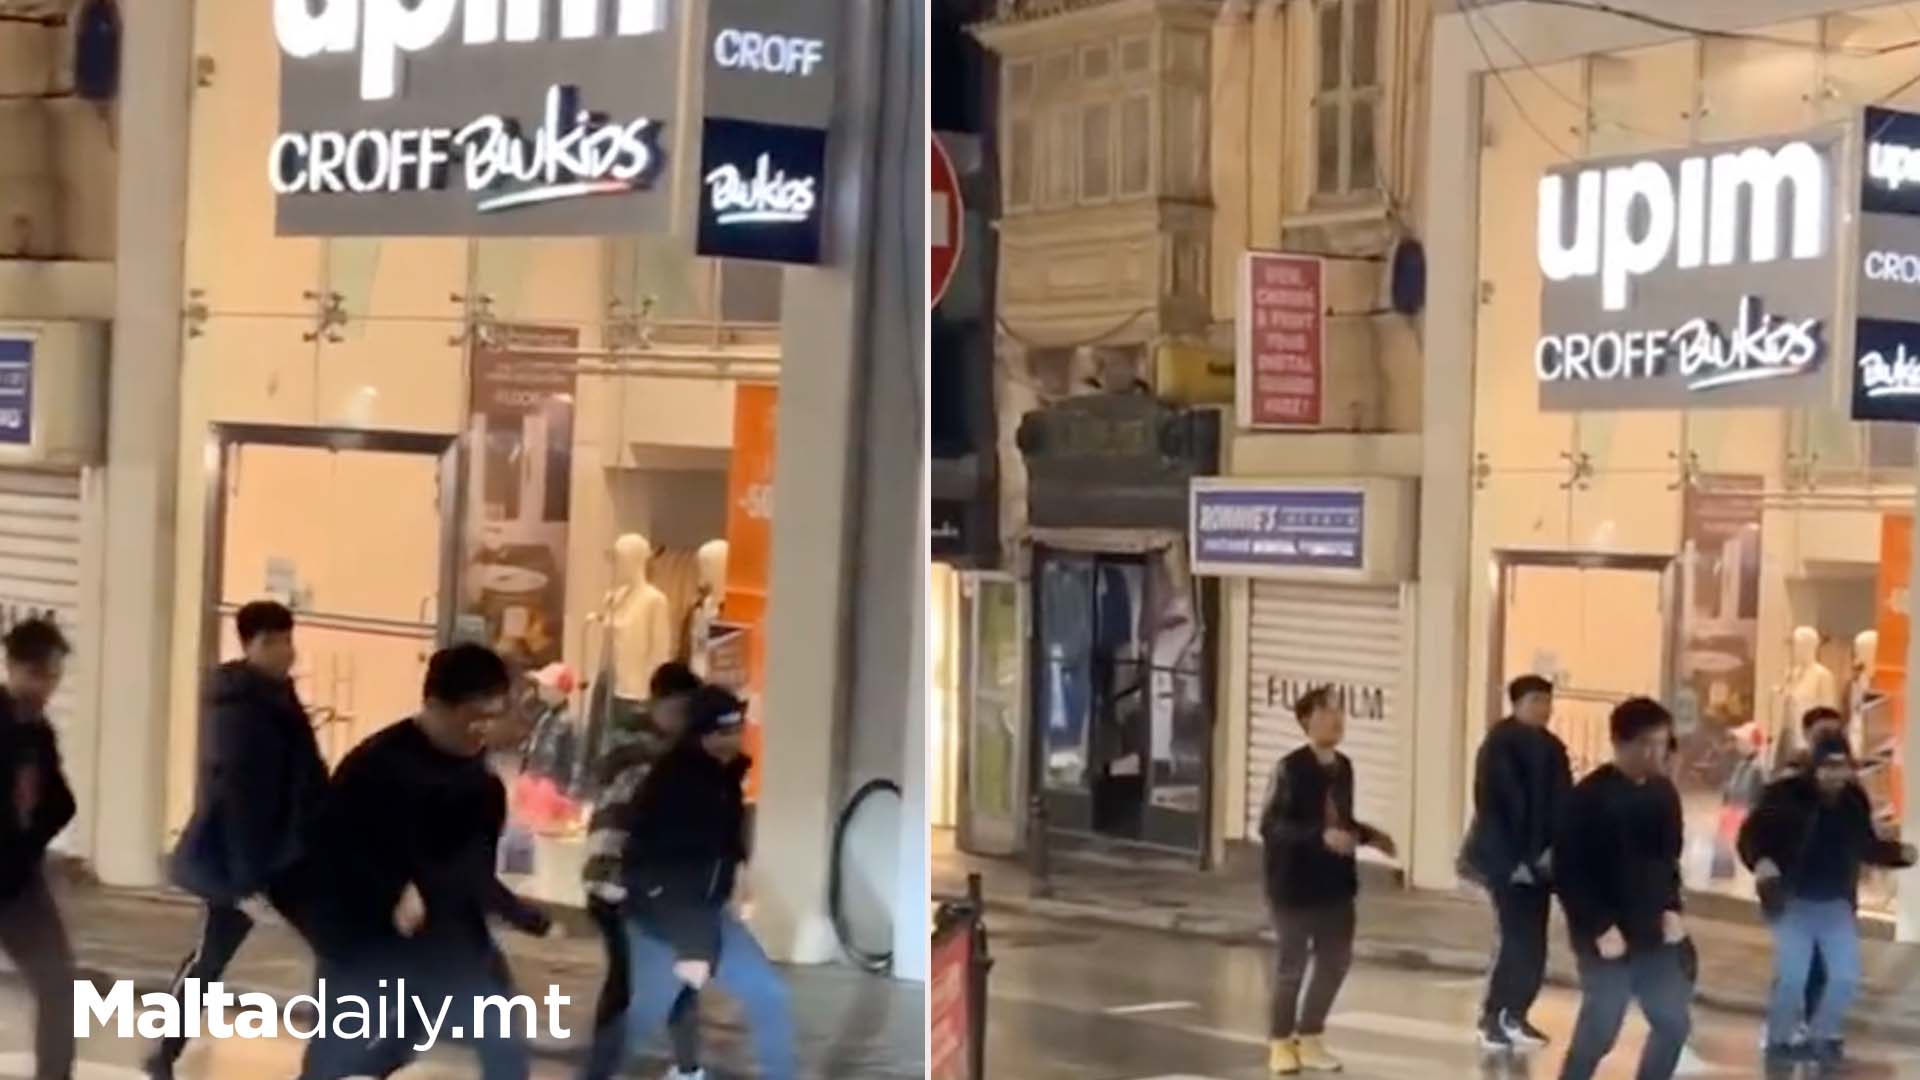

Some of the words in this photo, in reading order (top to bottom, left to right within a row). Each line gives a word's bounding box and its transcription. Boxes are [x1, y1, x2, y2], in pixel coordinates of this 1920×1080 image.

[714, 28, 824, 76] CROFF
[268, 128, 451, 194] CROFF
[1538, 141, 1826, 310] upim
[1535, 331, 1668, 381] CROFF
